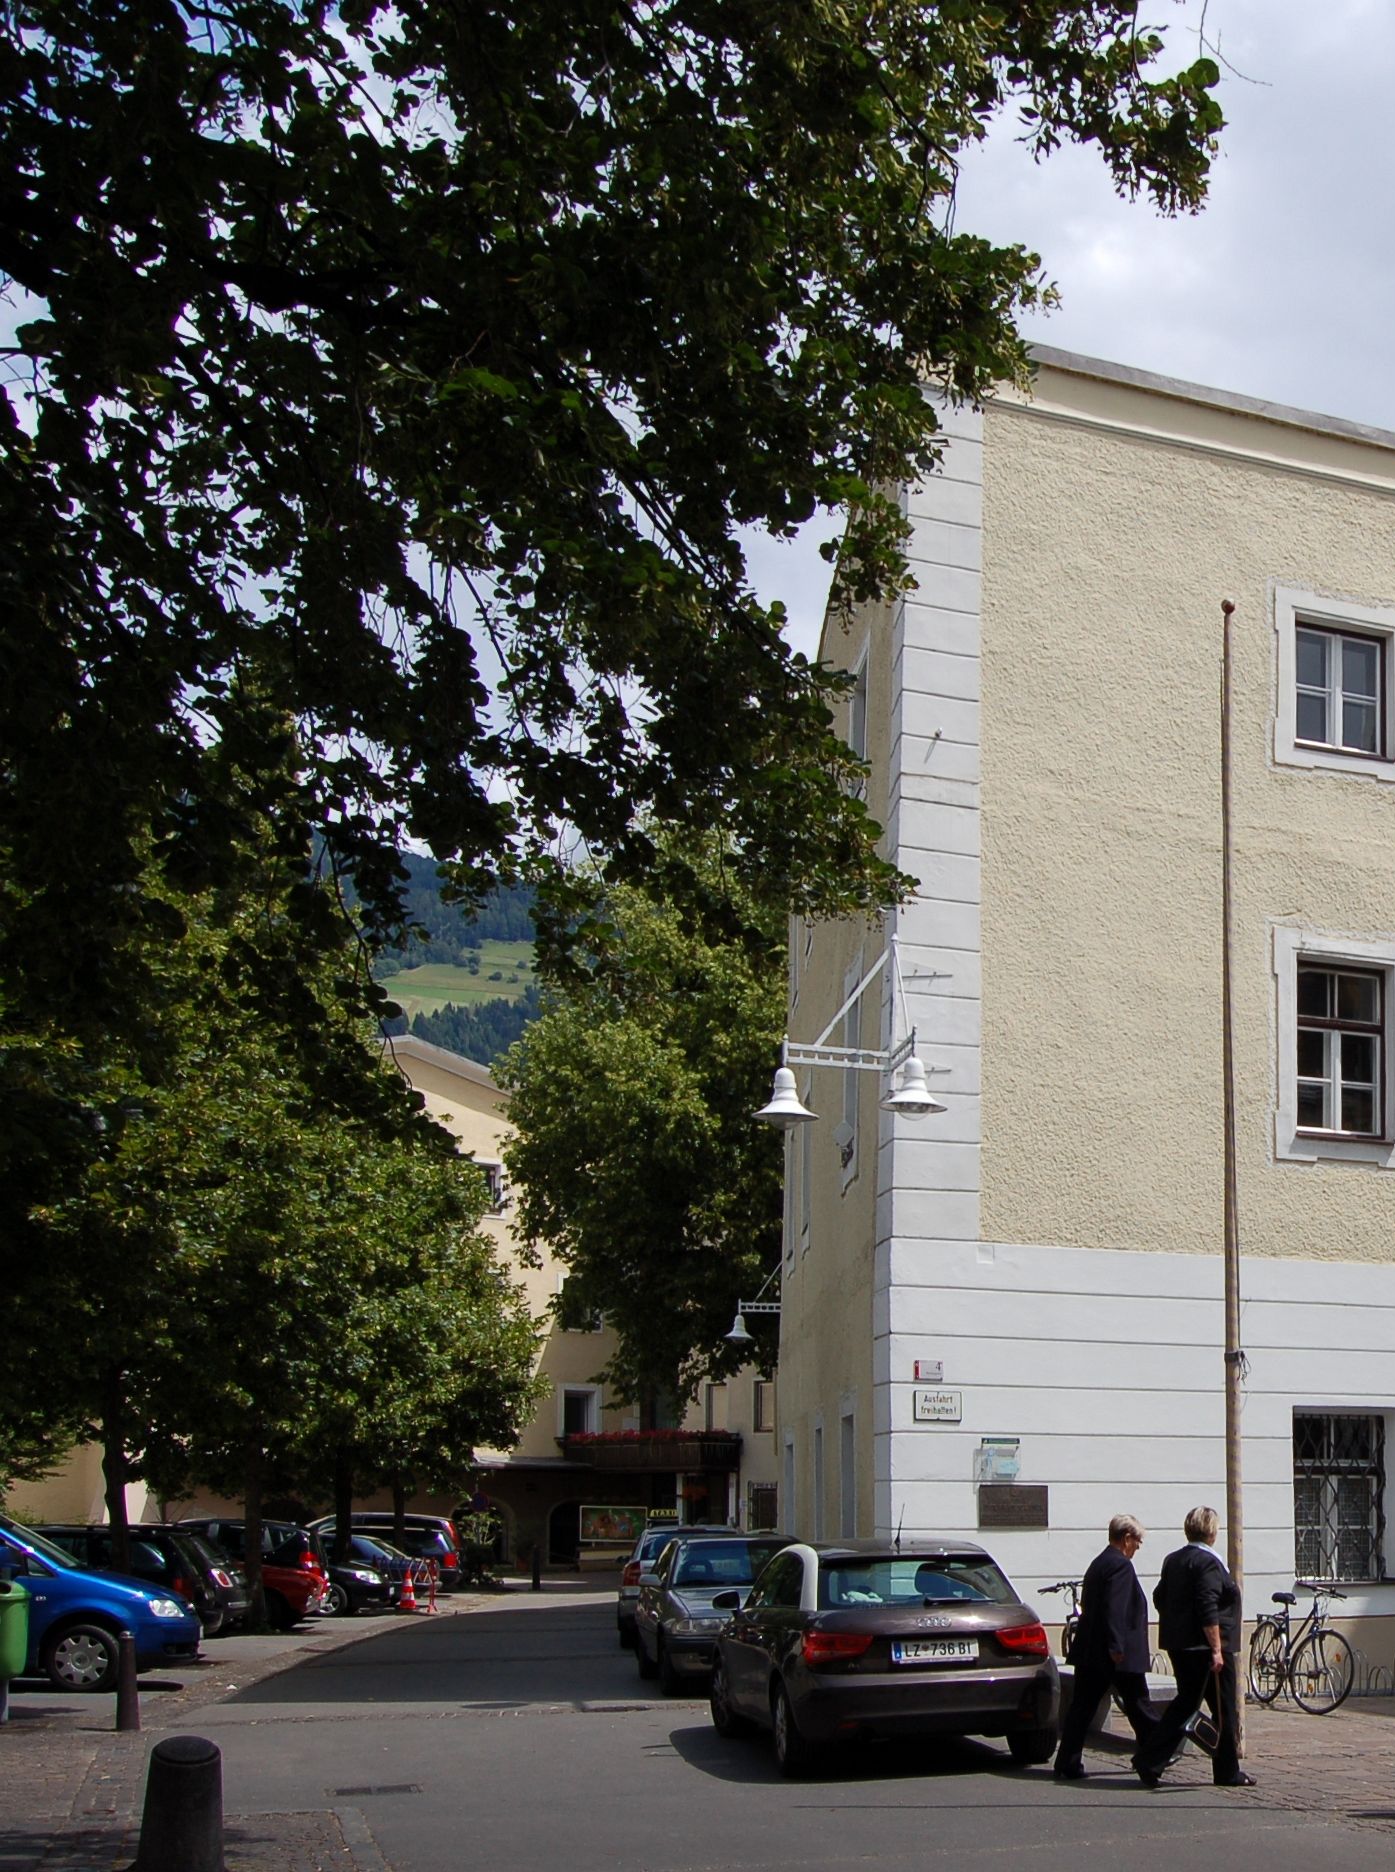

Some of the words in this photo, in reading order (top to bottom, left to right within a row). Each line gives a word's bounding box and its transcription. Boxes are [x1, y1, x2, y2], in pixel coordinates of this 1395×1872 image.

[924, 1394, 953, 1403] Ausfahrt
[921, 1406, 957, 1415] freihalten!
[905, 1644, 921, 1657] LZ
[931, 1643, 956, 1656] 736
[958, 1642, 972, 1655] BI
